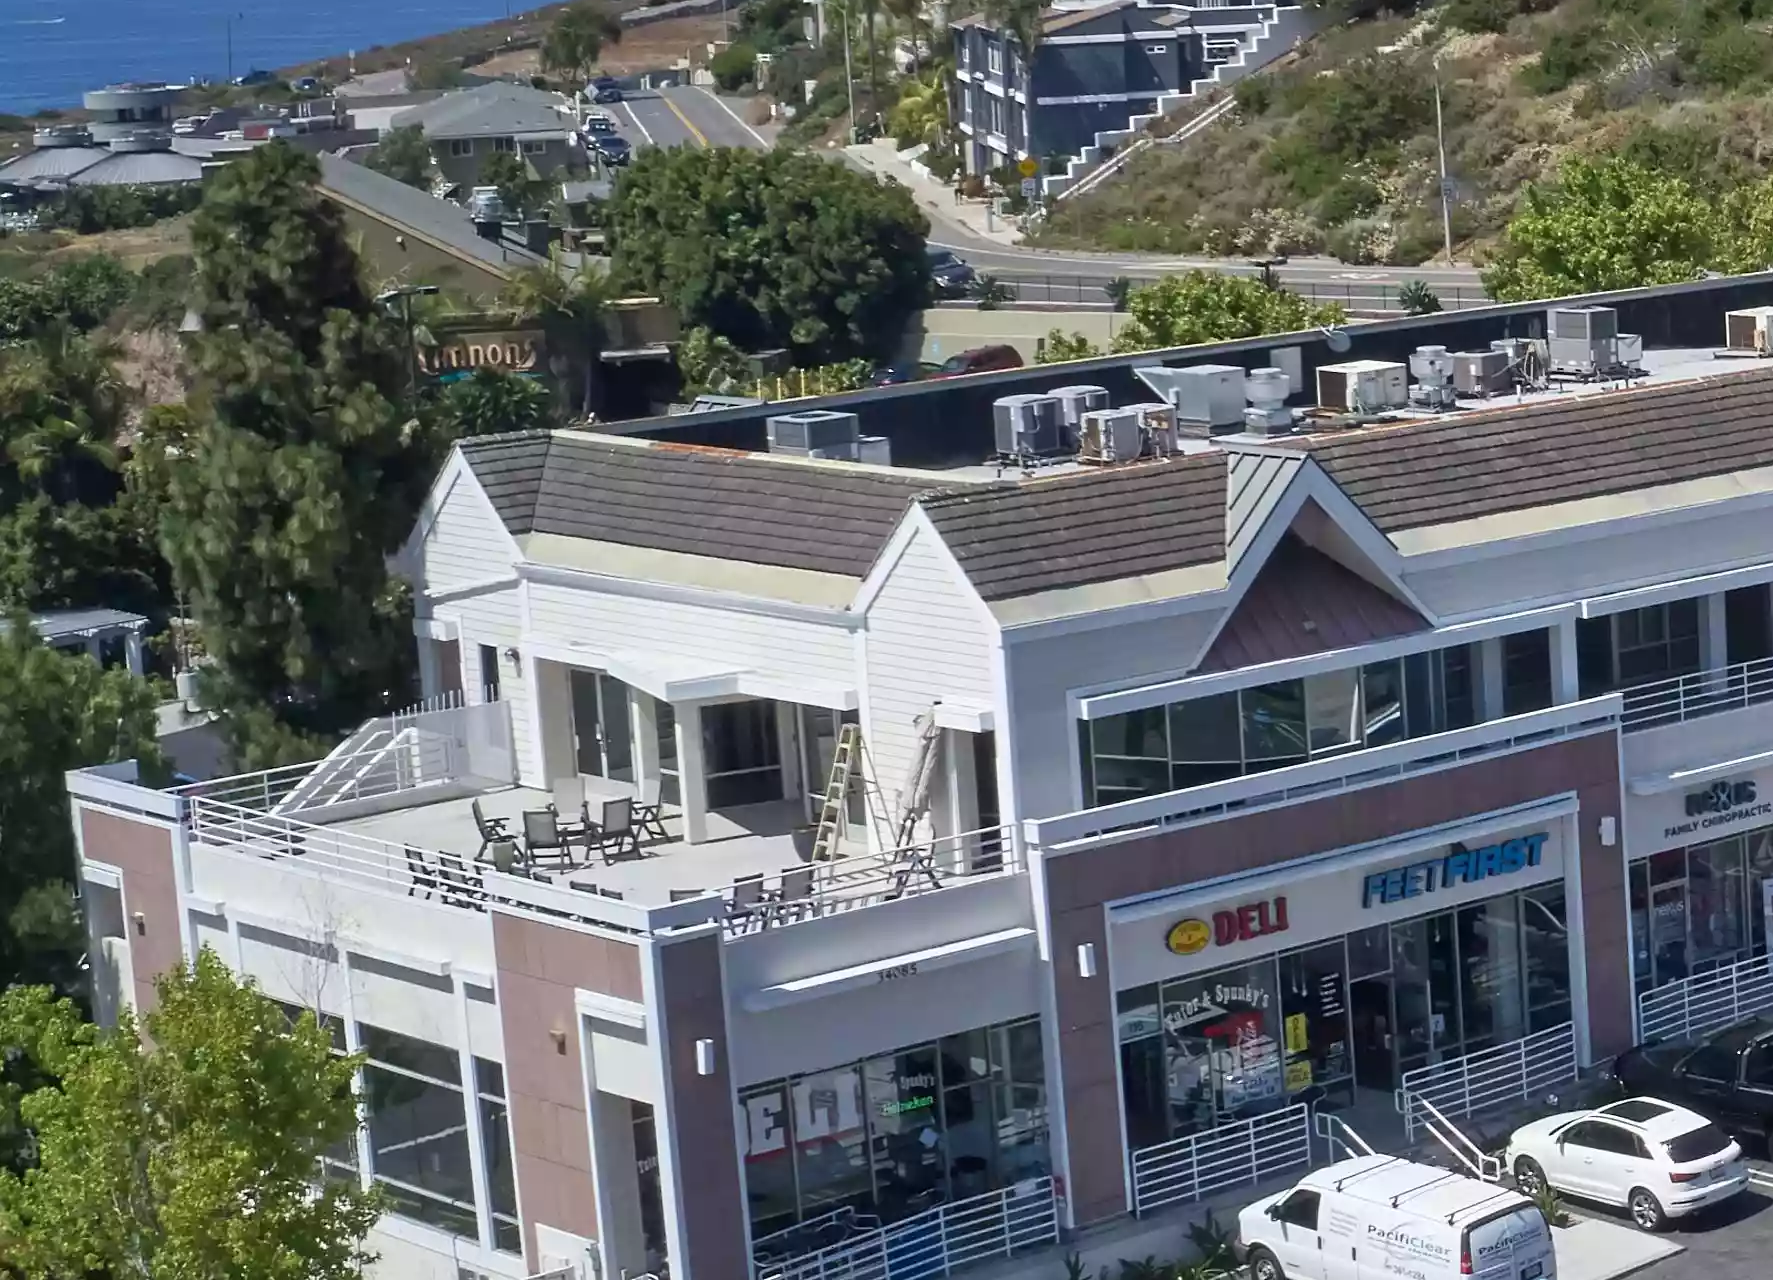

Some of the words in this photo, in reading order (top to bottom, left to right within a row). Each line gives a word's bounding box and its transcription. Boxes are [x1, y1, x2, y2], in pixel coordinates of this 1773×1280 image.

[1664, 821, 1700, 839] FAMILY
[1701, 802, 1772, 829] CHIROPRACTIC
[1361, 858, 1443, 909] FEET
[1442, 831, 1549, 889] FIRST
[1211, 896, 1290, 948] DELI
[1215, 983, 1270, 1009] Spunky's
[1367, 1223, 1453, 1255] PacifiClear
